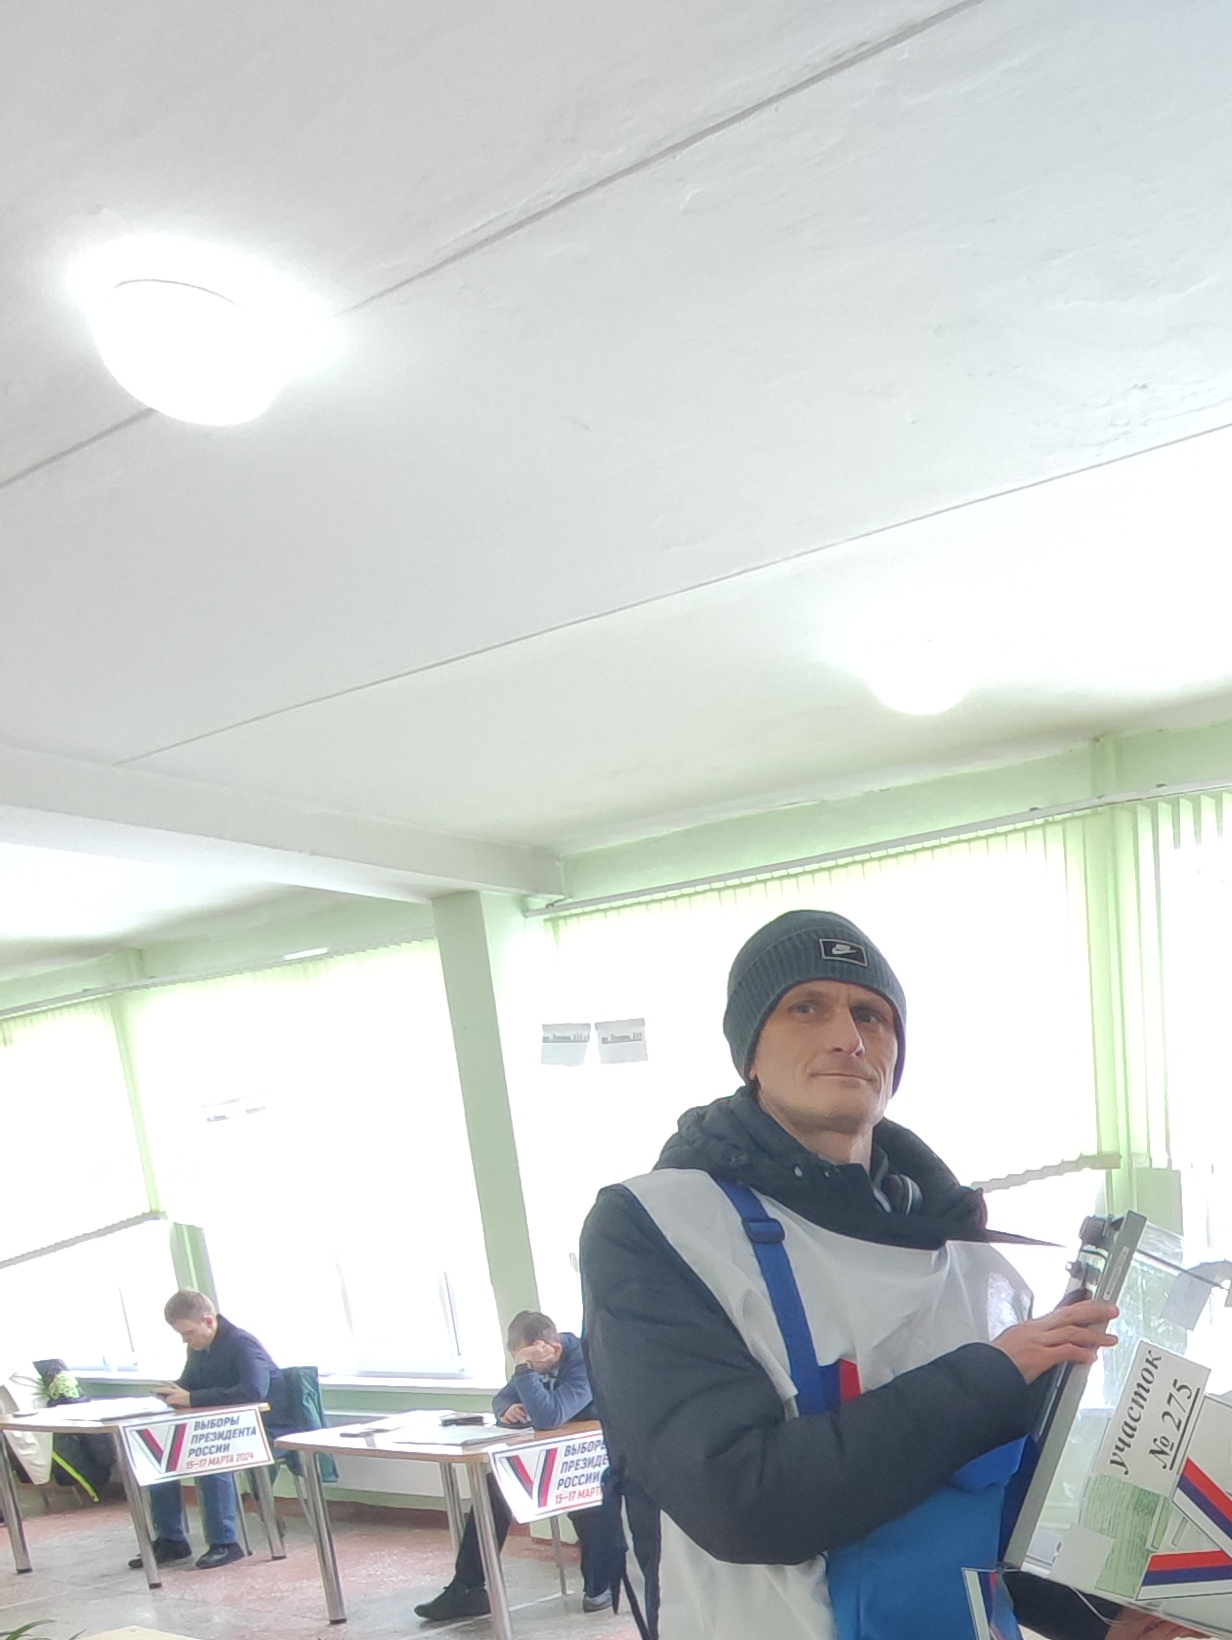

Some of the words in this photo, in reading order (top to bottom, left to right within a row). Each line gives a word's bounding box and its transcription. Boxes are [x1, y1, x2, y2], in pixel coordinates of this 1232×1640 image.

[1109, 1350, 1162, 1475] участок
[1161, 1378, 1193, 1432] 275
[194, 1416, 240, 1431] ВЫБОРЫ
[191, 1426, 257, 1445] ПРЕЗИДЕНТА
[188, 1443, 230, 1458] РОССИИ
[208, 1455, 234, 1467] МАРТА
[236, 1451, 254, 1463] 2024
[560, 1455, 609, 1474] ПРЕЗИДЕ
[557, 1471, 600, 1490] РОССИИ
